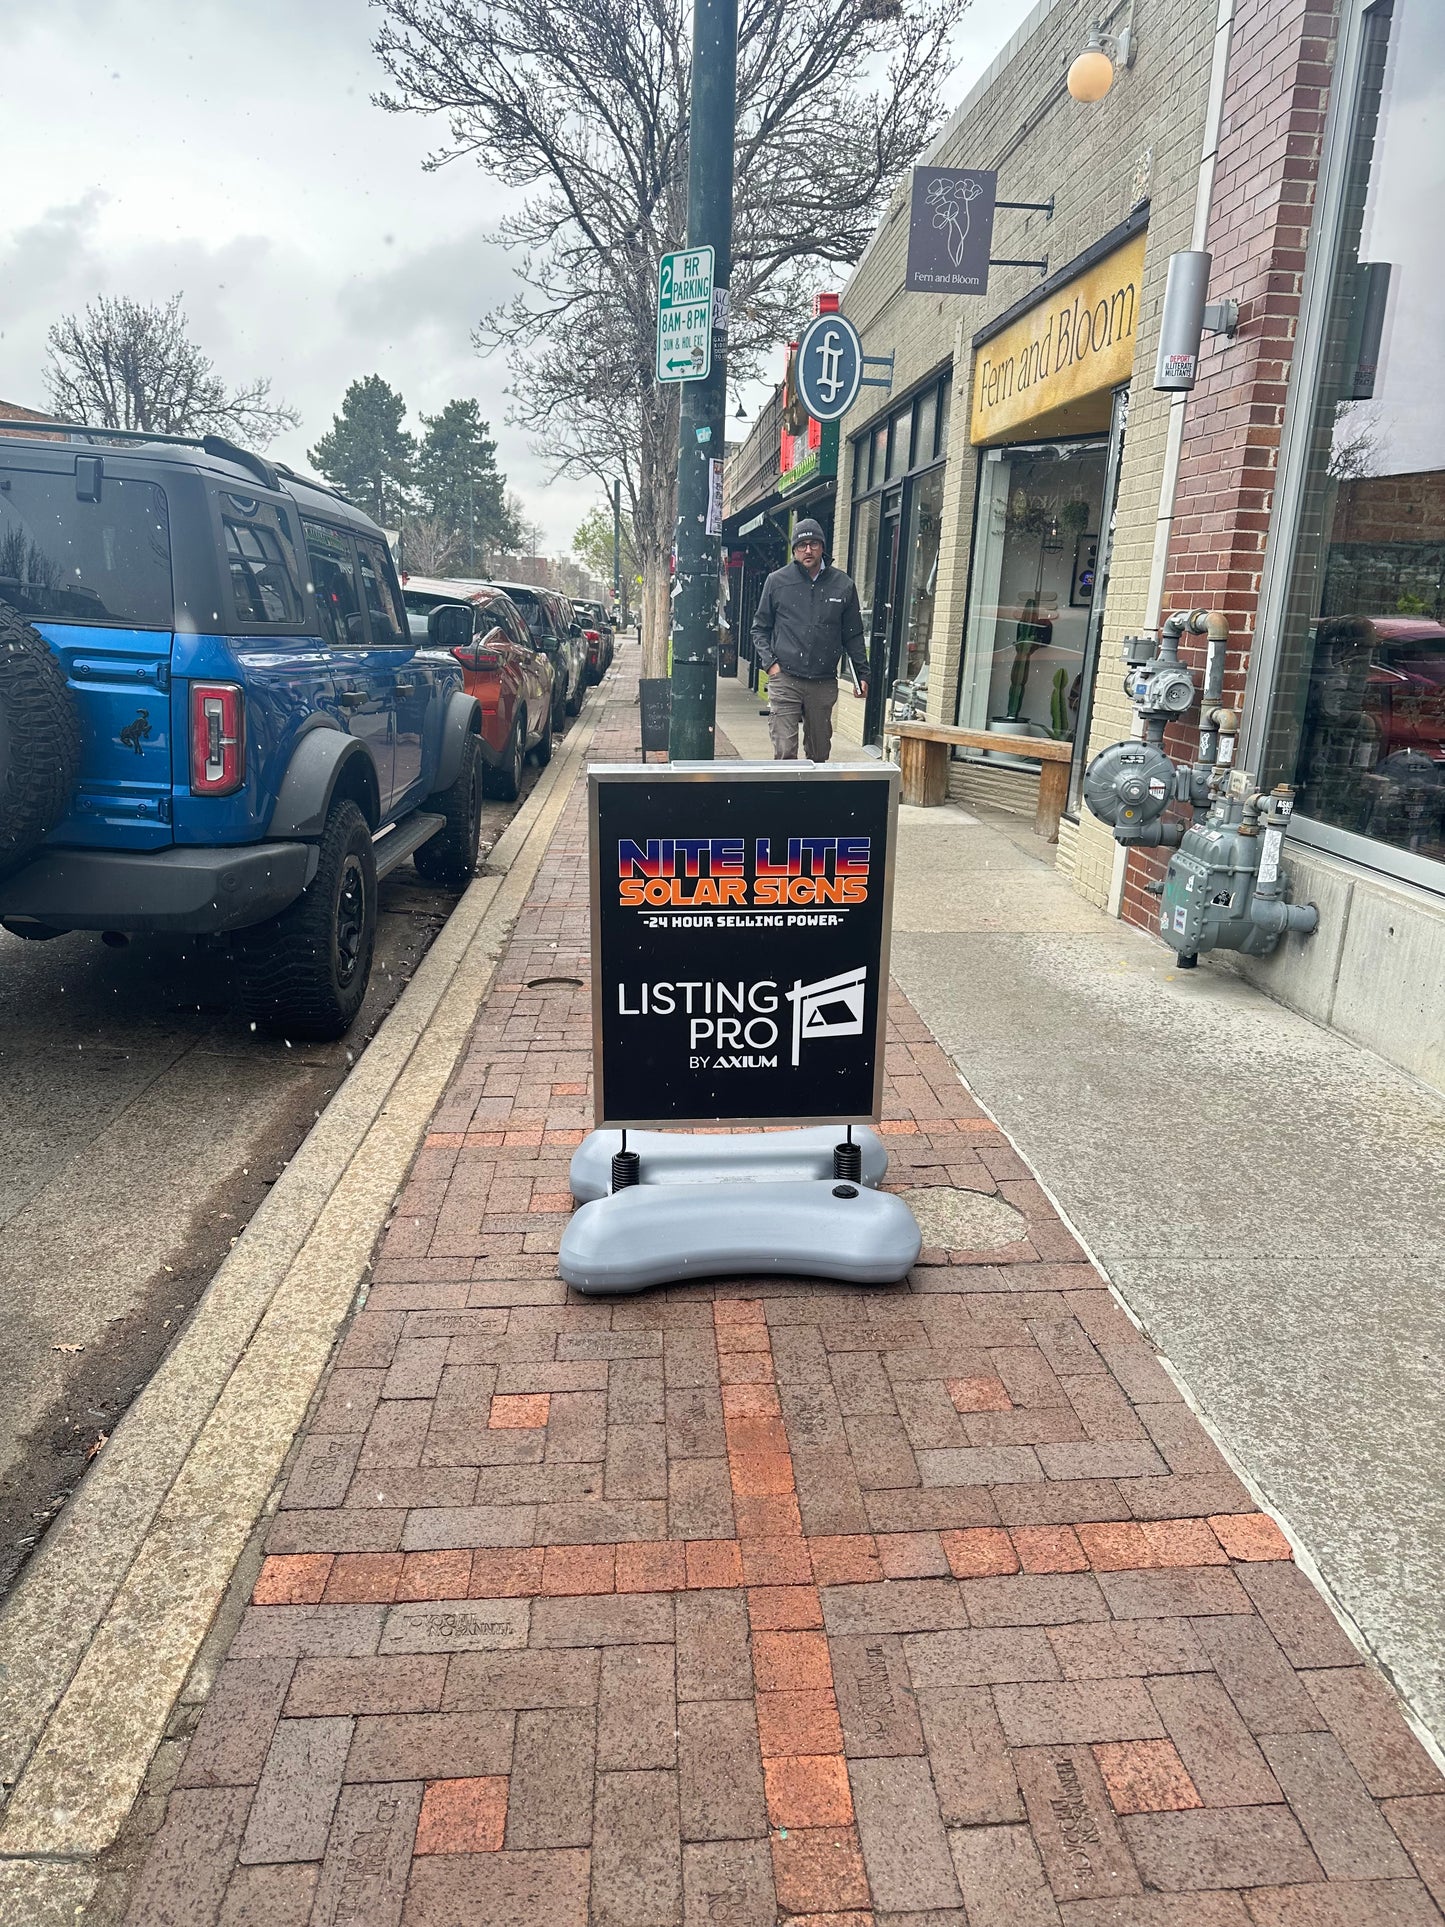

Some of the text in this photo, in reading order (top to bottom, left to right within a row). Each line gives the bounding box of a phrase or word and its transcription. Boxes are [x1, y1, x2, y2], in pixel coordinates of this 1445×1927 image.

[661, 256, 700, 300] 2 HR
[673, 277, 709, 302] PARKING
[914, 271, 980, 285] Fern and Bloom
[663, 339, 674, 351] SUN
[675, 338, 680, 350] &
[694, 334, 704, 347] EXC
[979, 283, 1135, 413] Fern and Bloom
[1164, 362, 1193, 370] ILLITERATE
[1164, 369, 1192, 377] MILITANTS
[618, 837, 871, 878] NITE LITE
[618, 876, 868, 907] SOLAR SIGNS
[671, 916, 714, 928] HOUR
[716, 915, 784, 928] SELLING
[618, 980, 779, 1015] LISTING
[689, 1016, 779, 1050] PRO
[689, 1055, 778, 1069] BY AXIUM
